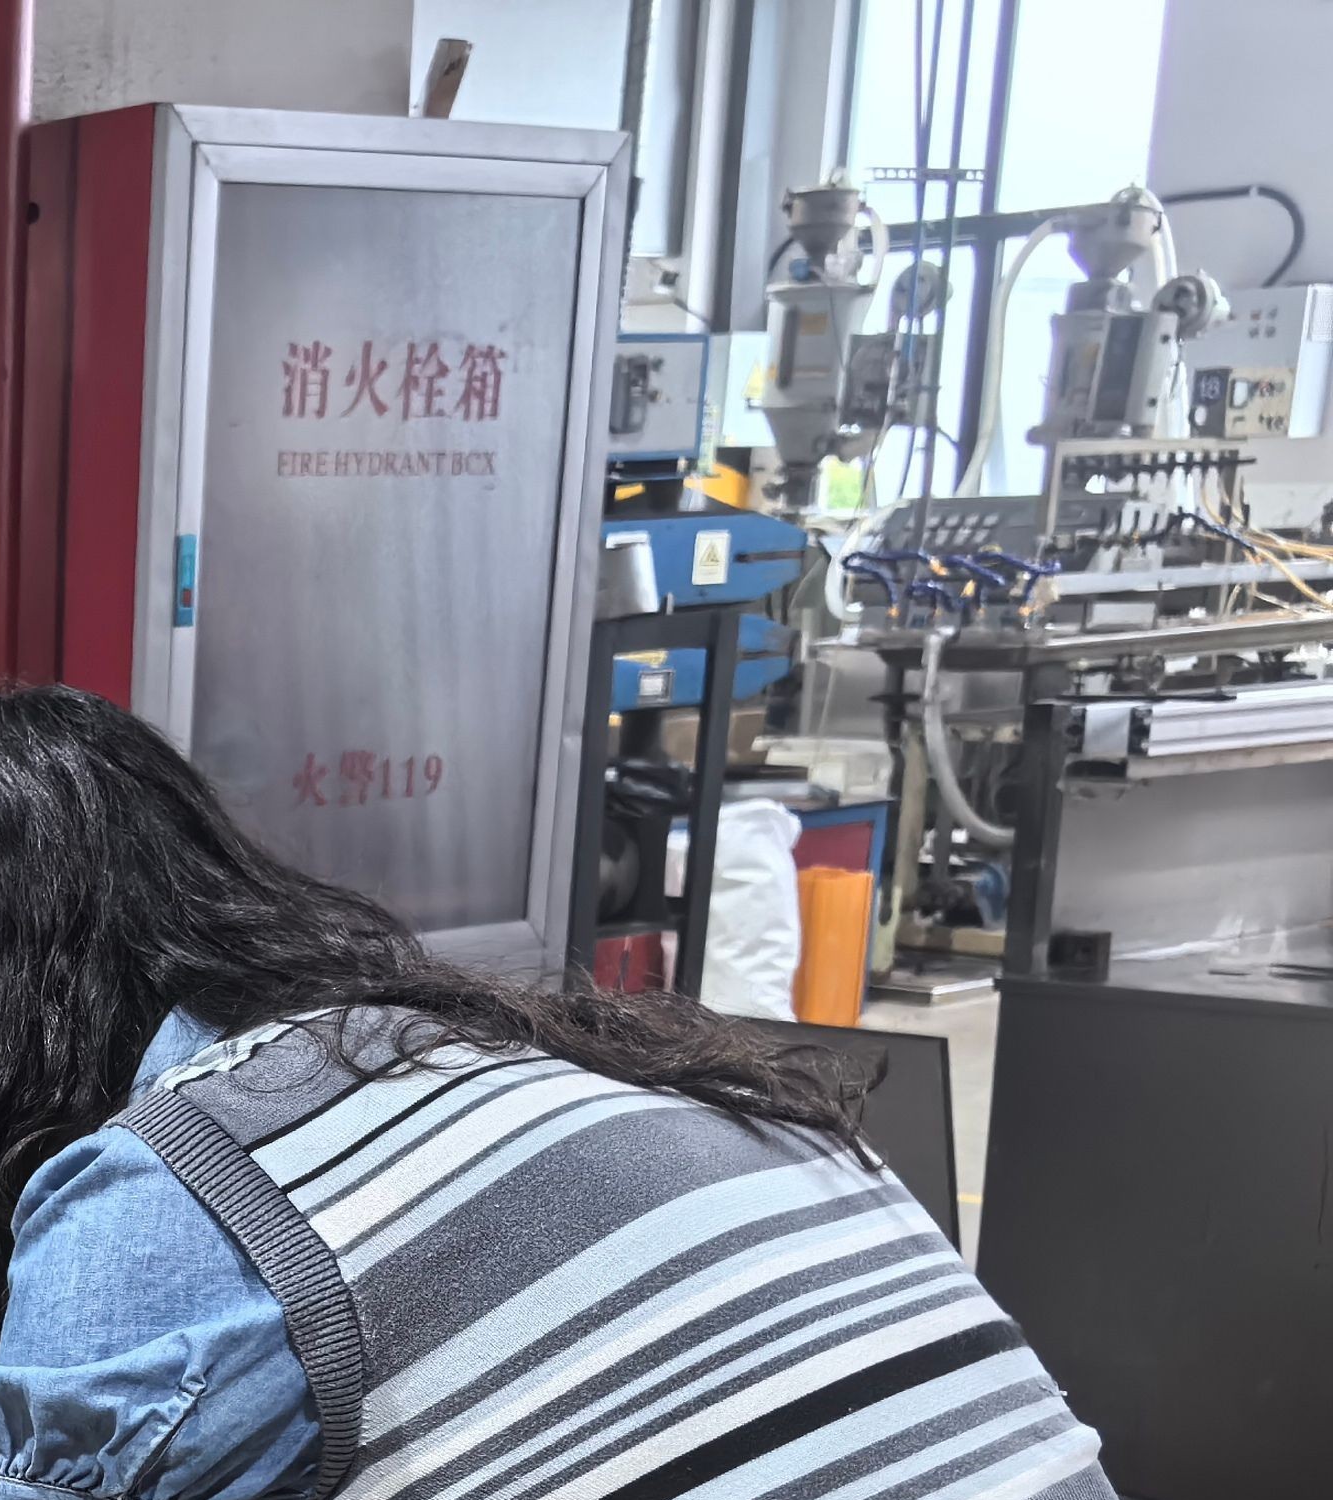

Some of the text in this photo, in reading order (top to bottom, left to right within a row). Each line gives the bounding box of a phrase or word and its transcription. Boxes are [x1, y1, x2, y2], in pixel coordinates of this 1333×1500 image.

[282, 340, 506, 421] 消火栓箱
[278, 452, 329, 477] FIRE
[335, 452, 447, 477] HYDRANT
